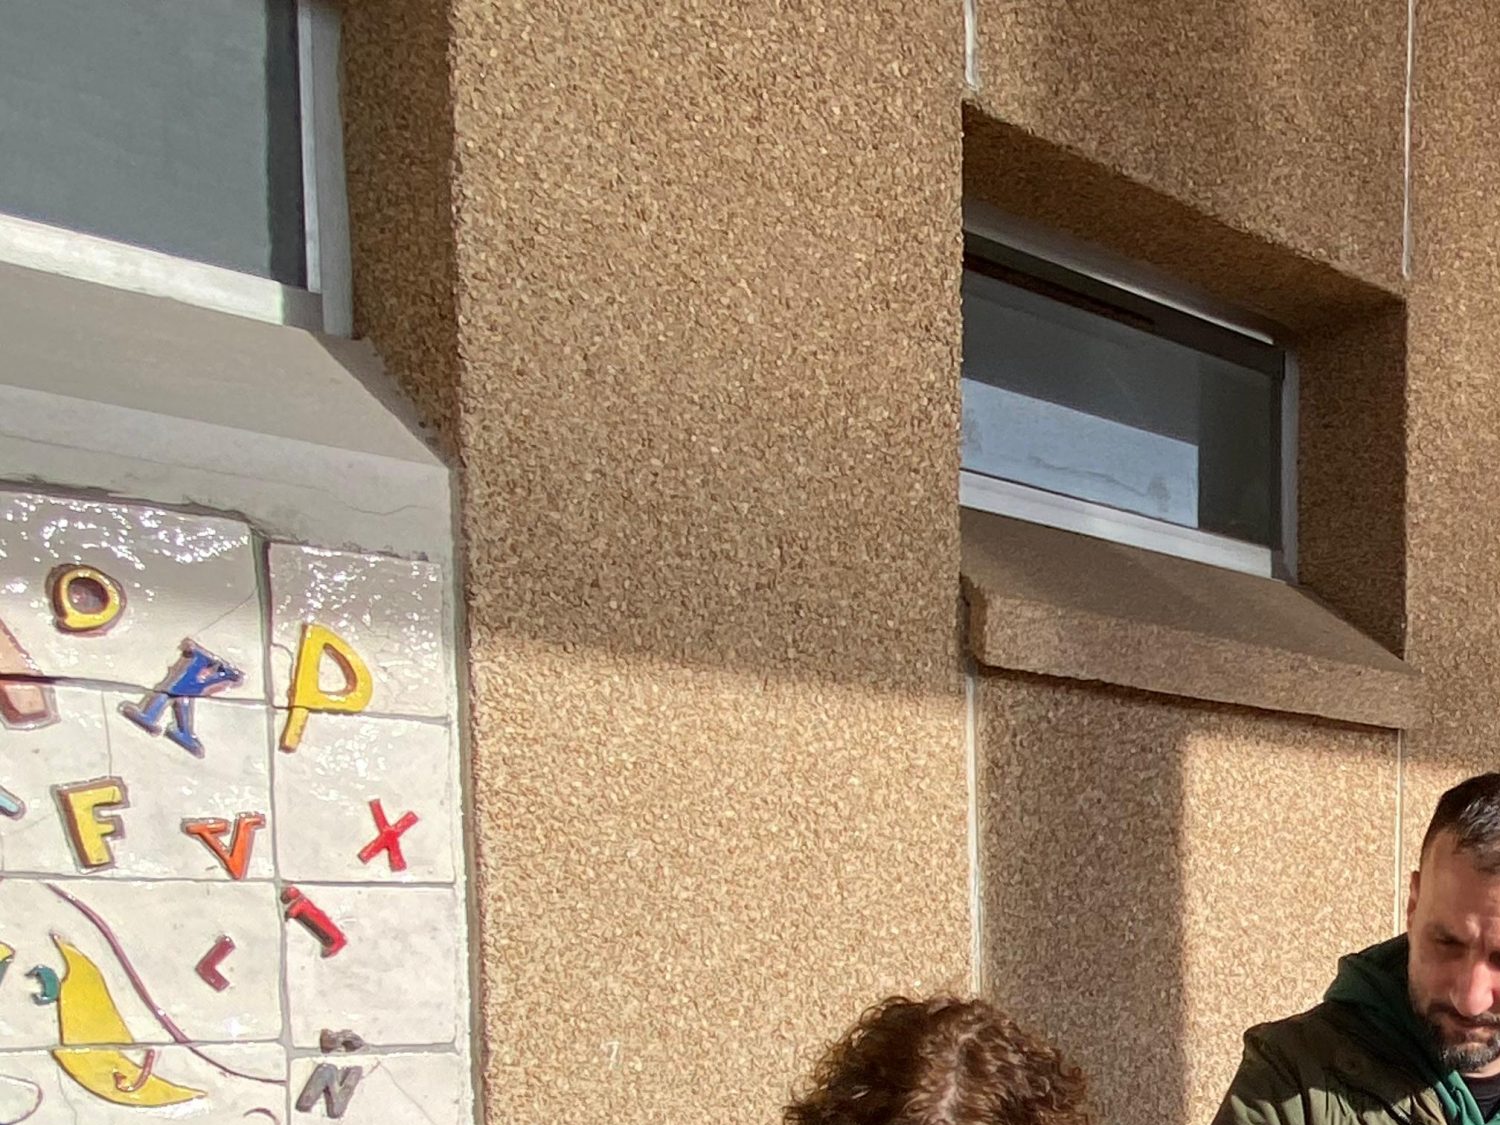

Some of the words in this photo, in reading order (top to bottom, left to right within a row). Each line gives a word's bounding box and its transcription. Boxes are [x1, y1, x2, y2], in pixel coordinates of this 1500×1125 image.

[278, 622, 373, 754] P
[50, 775, 130, 873] F
[180, 811, 267, 881] V
[357, 797, 420, 873] X
